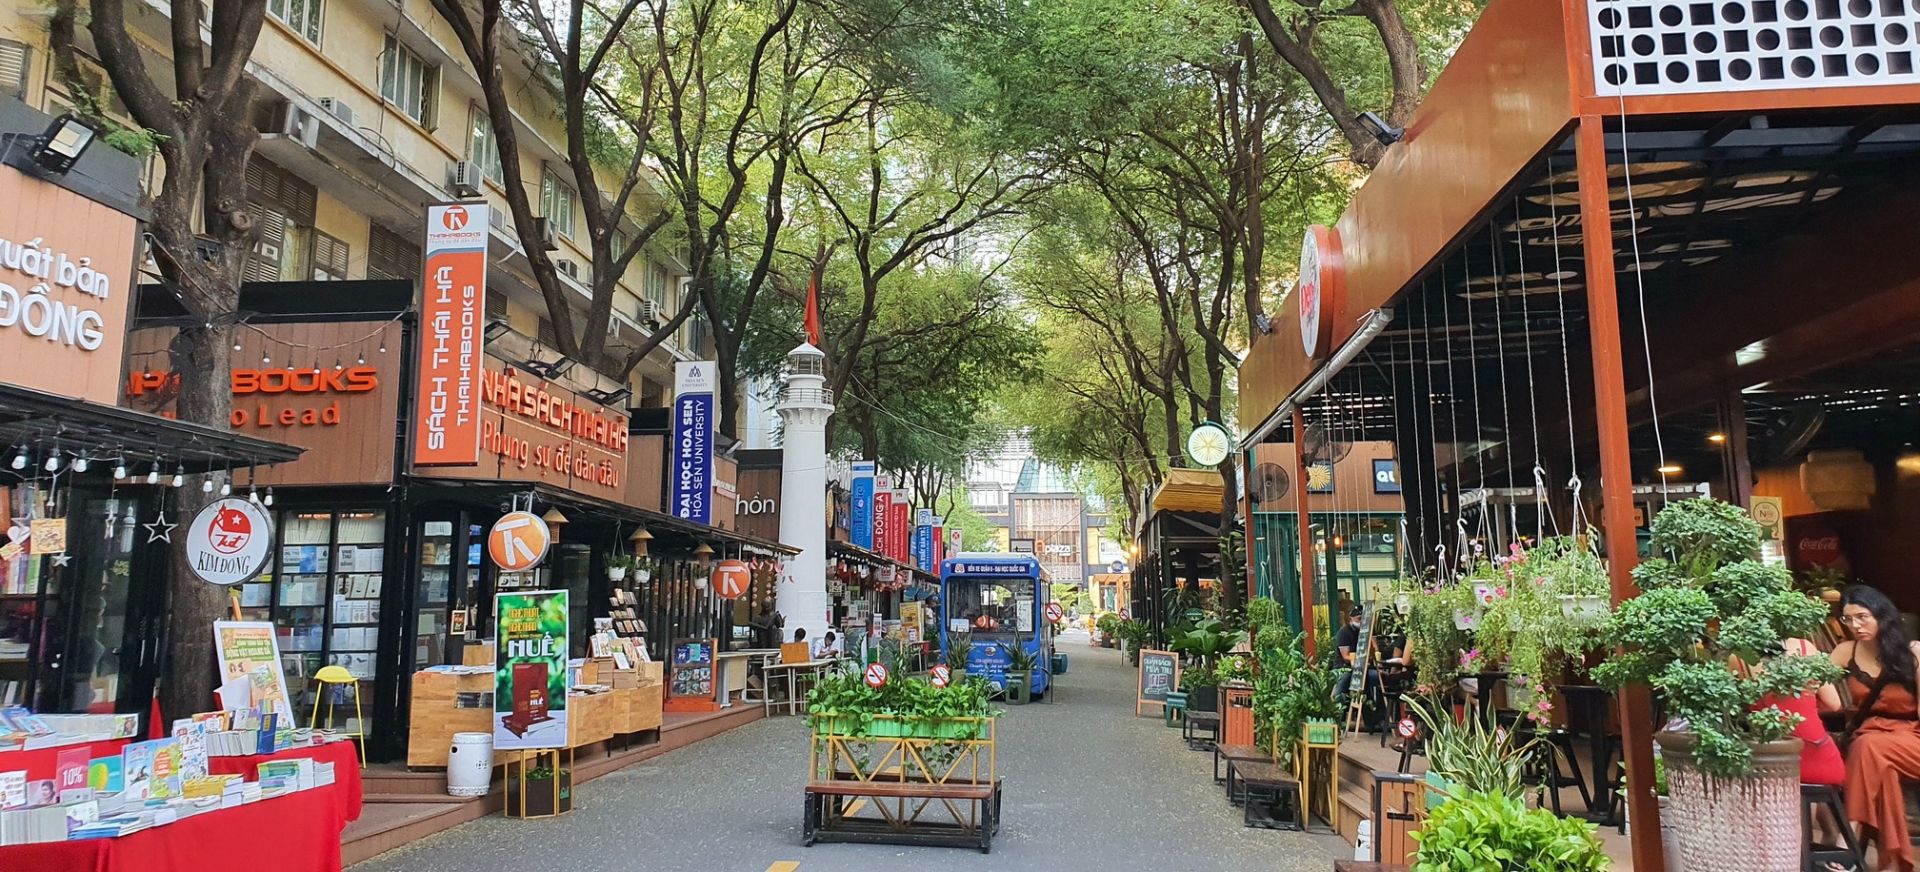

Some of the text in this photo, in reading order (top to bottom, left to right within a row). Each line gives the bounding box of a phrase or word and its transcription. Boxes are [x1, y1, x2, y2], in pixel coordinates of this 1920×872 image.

[55, 252, 110, 300] bản
[426, 266, 453, 450] SÁCH THÁI HÀ
[457, 285, 475, 426] THAIHABOOKS
[258, 399, 341, 427] Lead
[482, 367, 629, 453] NHÀ SÁCH THÁI HÀ
[480, 420, 528, 469] Phụng
[680, 400, 694, 519] ĐẠI HỌC HOA SEN
[693, 400, 705, 518] HOA SEN UNIVERSITY
[197, 551, 219, 572] KIM
[508, 631, 554, 658] HUẾ
[62, 767, 84, 787] 10%
